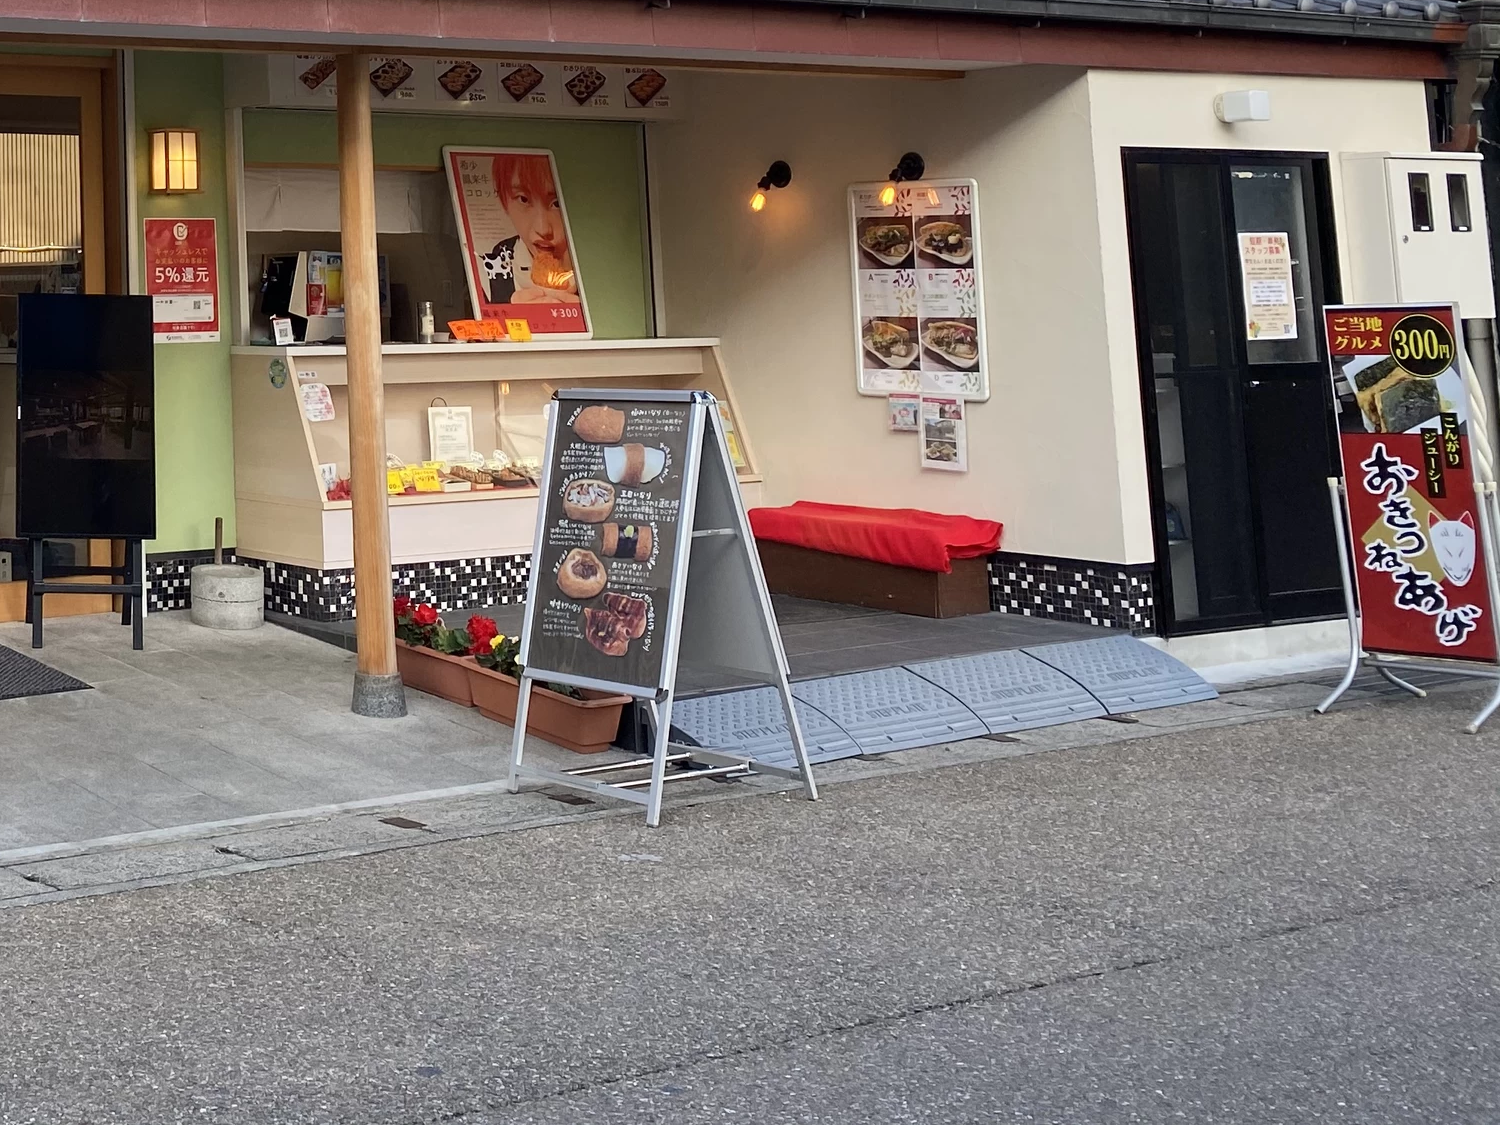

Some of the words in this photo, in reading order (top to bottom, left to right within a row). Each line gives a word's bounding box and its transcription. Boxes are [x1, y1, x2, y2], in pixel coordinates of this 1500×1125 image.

[155, 247, 208, 256] キャッシュレスで
[155, 267, 210, 283] 5%還元
[550, 308, 578, 318] ¥300
[1333, 316, 1383, 332] ご当地
[1334, 335, 1383, 351] グルメ
[1394, 329, 1450, 360] 300円
[1443, 416, 1459, 467] こんがり
[1423, 432, 1439, 495] ジューシー
